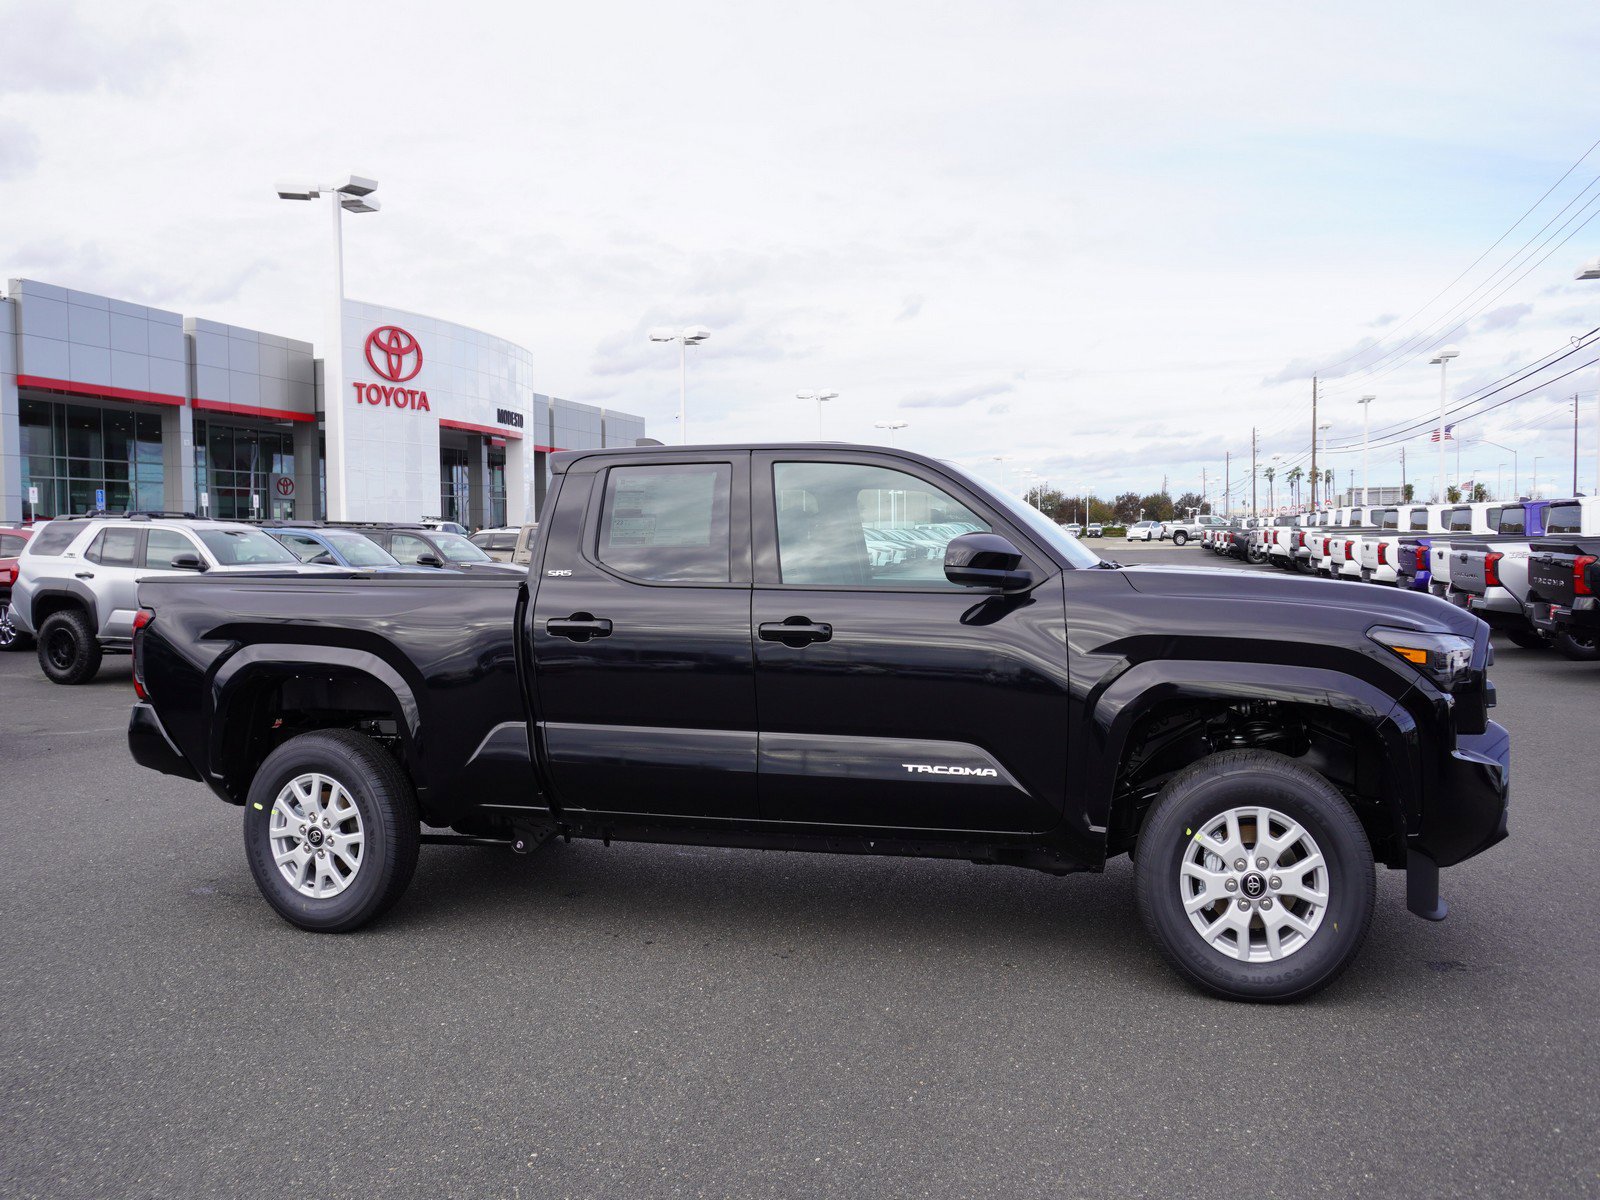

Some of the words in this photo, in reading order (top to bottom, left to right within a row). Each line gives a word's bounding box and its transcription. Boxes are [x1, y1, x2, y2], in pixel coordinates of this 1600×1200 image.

[353, 382, 431, 411] TOYOTA
[497, 408, 523, 428] MODESTO
[548, 569, 573, 577] SR5
[1533, 576, 1565, 587] TACOMA
[902, 764, 998, 777] TACOMA
